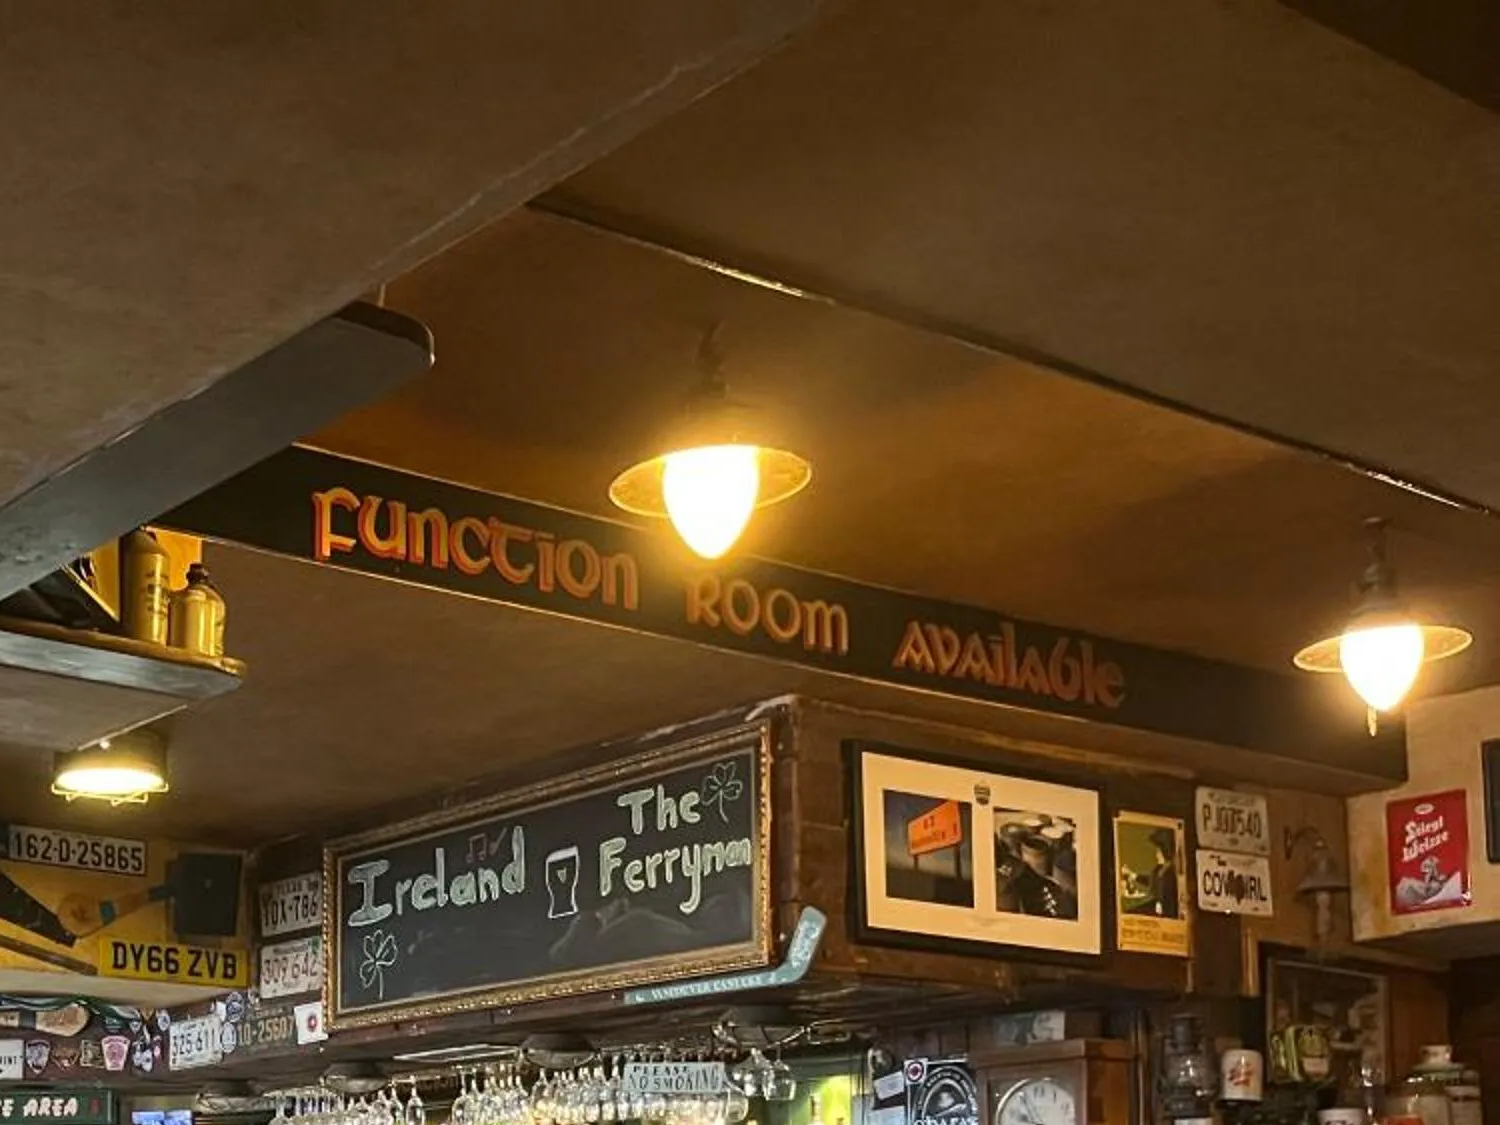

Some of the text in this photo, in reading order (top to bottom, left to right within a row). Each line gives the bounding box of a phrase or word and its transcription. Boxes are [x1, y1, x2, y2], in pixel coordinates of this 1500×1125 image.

[617, 784, 701, 834] The
[347, 825, 526, 928] Ireland
[600, 836, 752, 915] Ferryman
[111, 942, 238, 980] DY66 ZVB
[23, 1096, 79, 1117] AREA
